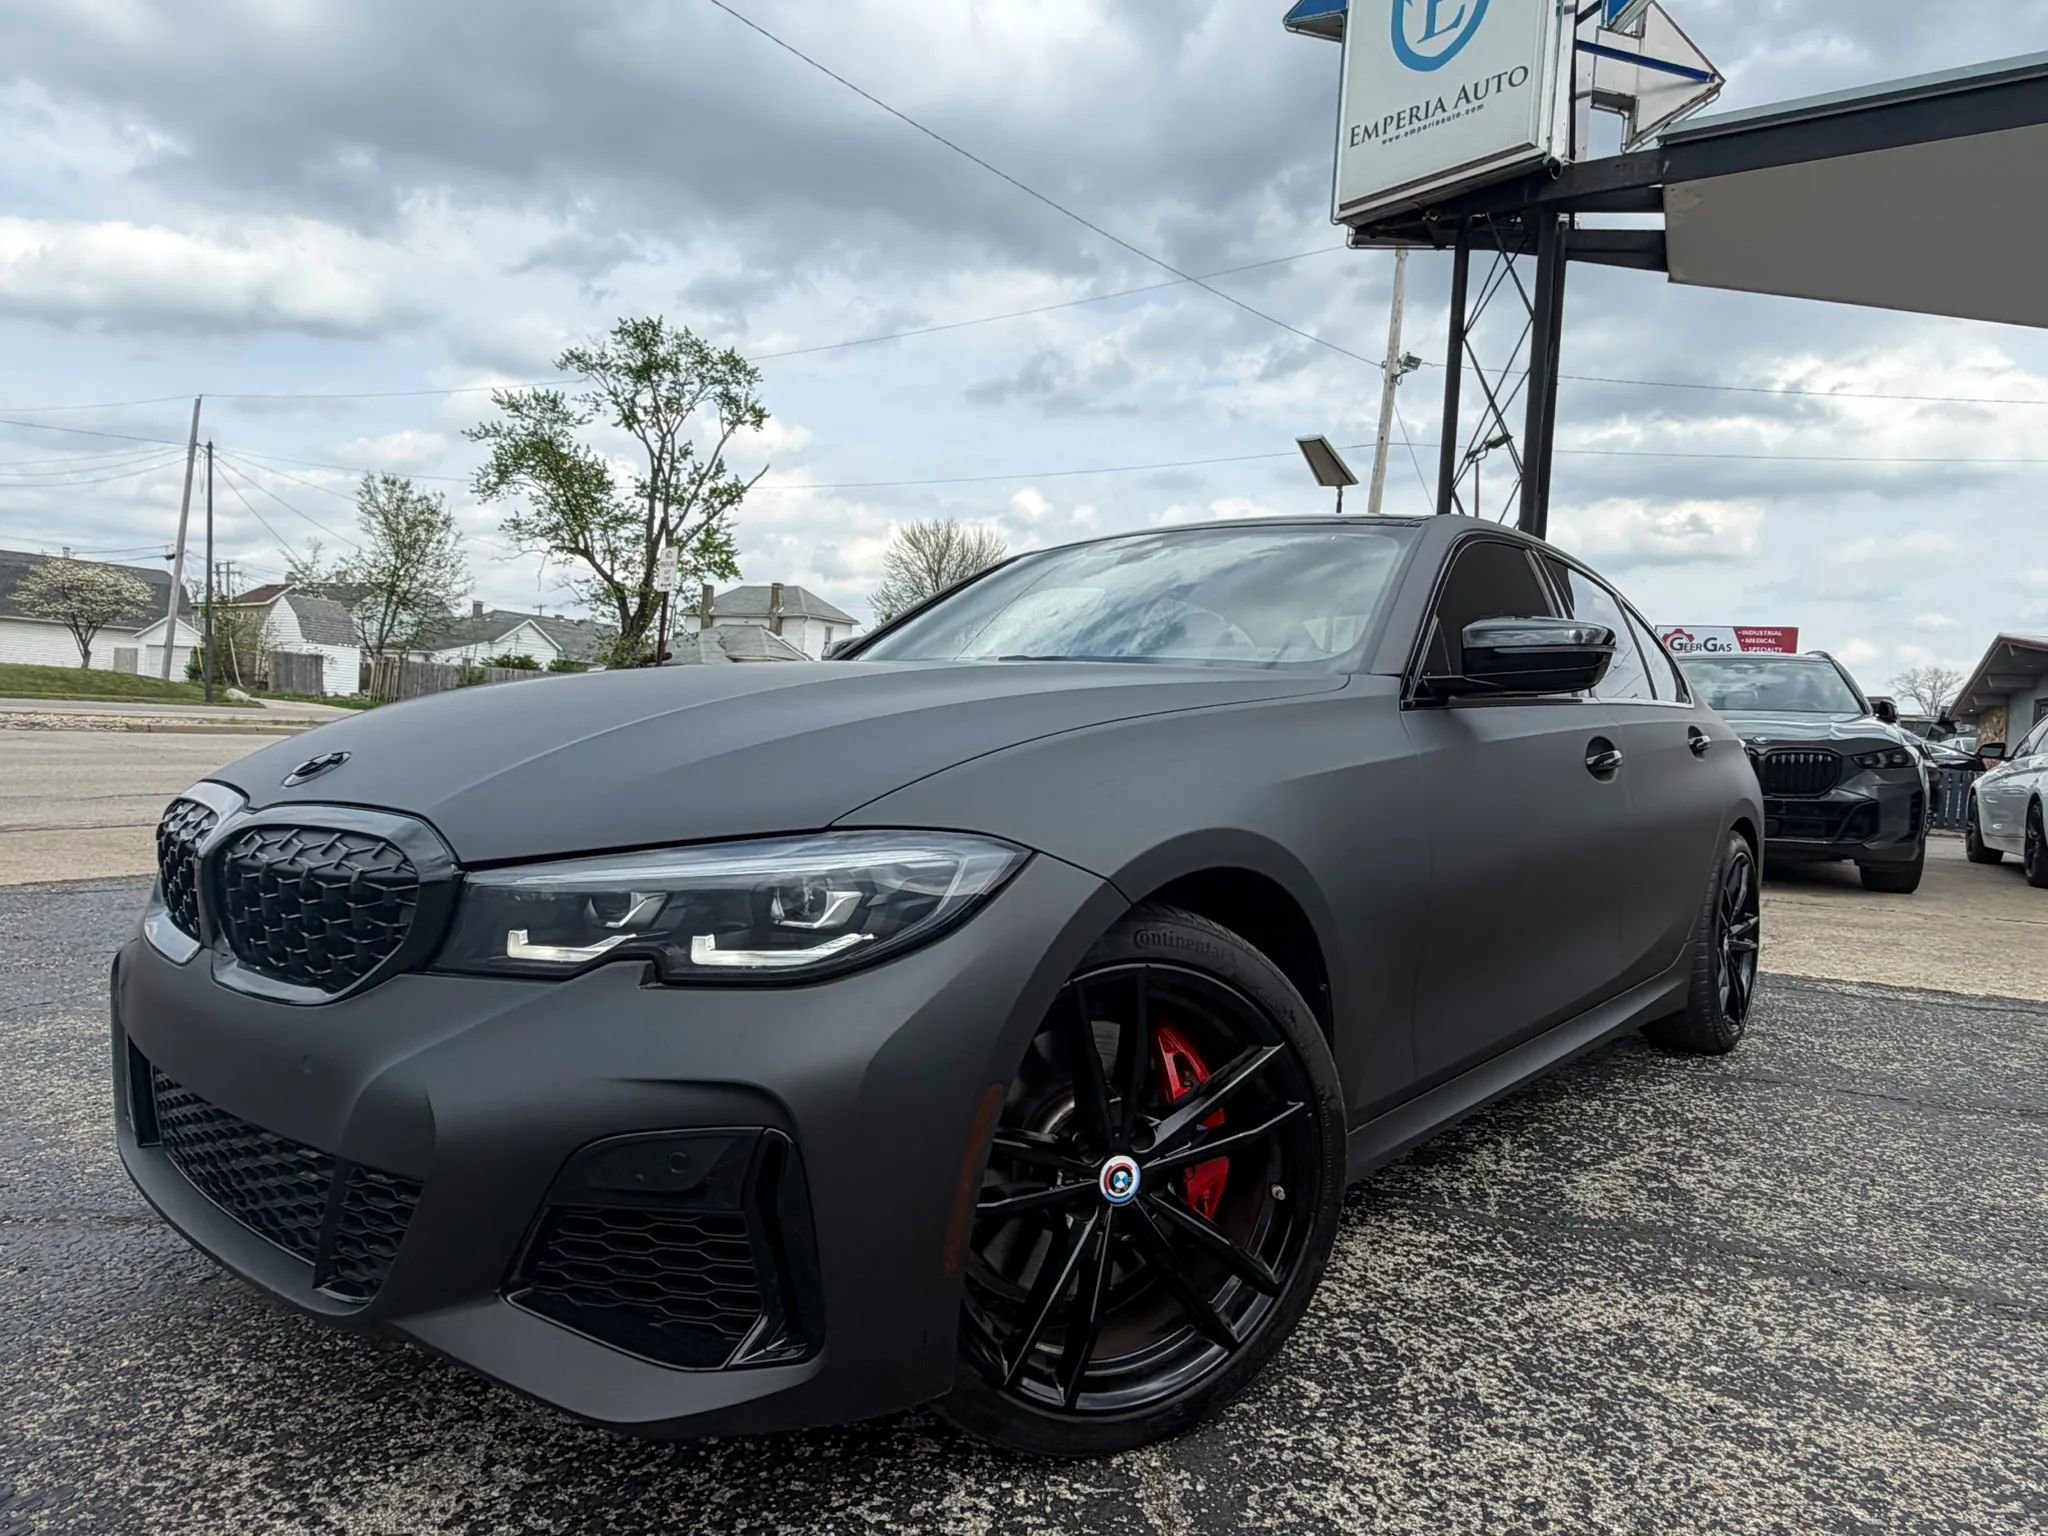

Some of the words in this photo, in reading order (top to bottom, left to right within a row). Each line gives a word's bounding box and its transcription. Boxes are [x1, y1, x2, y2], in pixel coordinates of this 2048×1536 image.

[1349, 96, 1448, 148] EMPERIA
[1453, 65, 1530, 110] AUTO
[1381, 103, 1485, 145] www.emperiaauto.com
[1133, 928, 1226, 959] Continental
